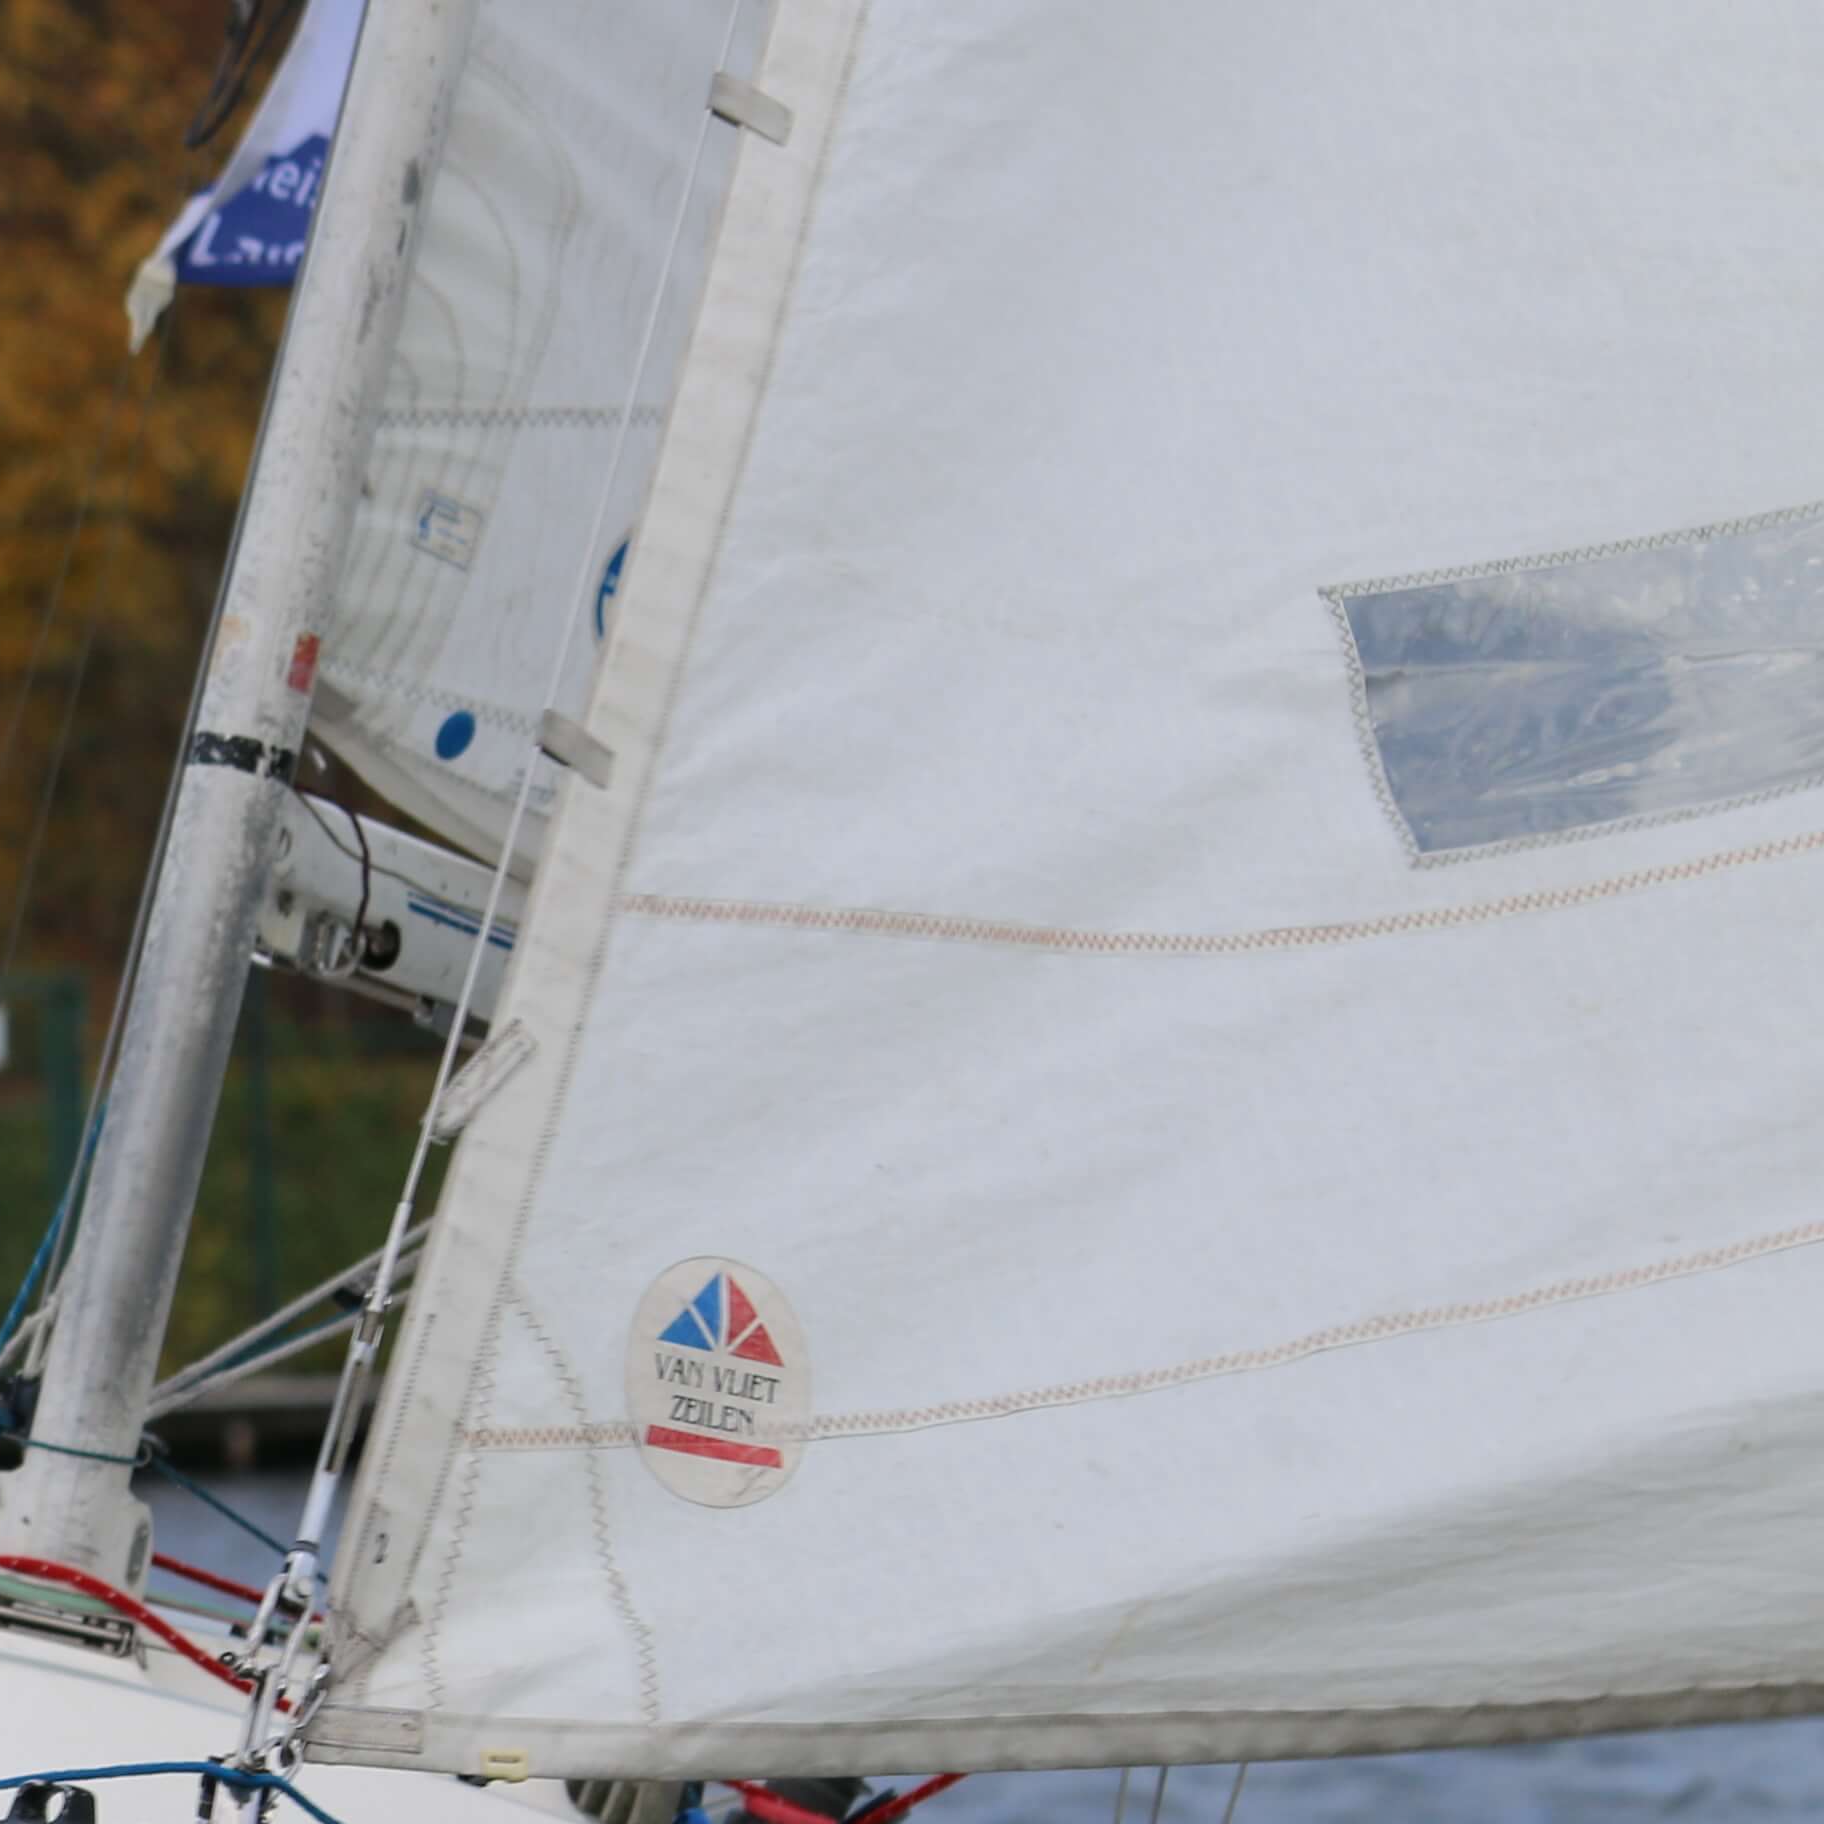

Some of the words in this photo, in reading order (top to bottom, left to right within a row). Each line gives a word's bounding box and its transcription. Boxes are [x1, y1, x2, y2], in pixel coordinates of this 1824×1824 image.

[654, 1351, 705, 1389] VAN
[712, 1364, 781, 1405] VLIET
[668, 1394, 756, 1434] ZEILEN
